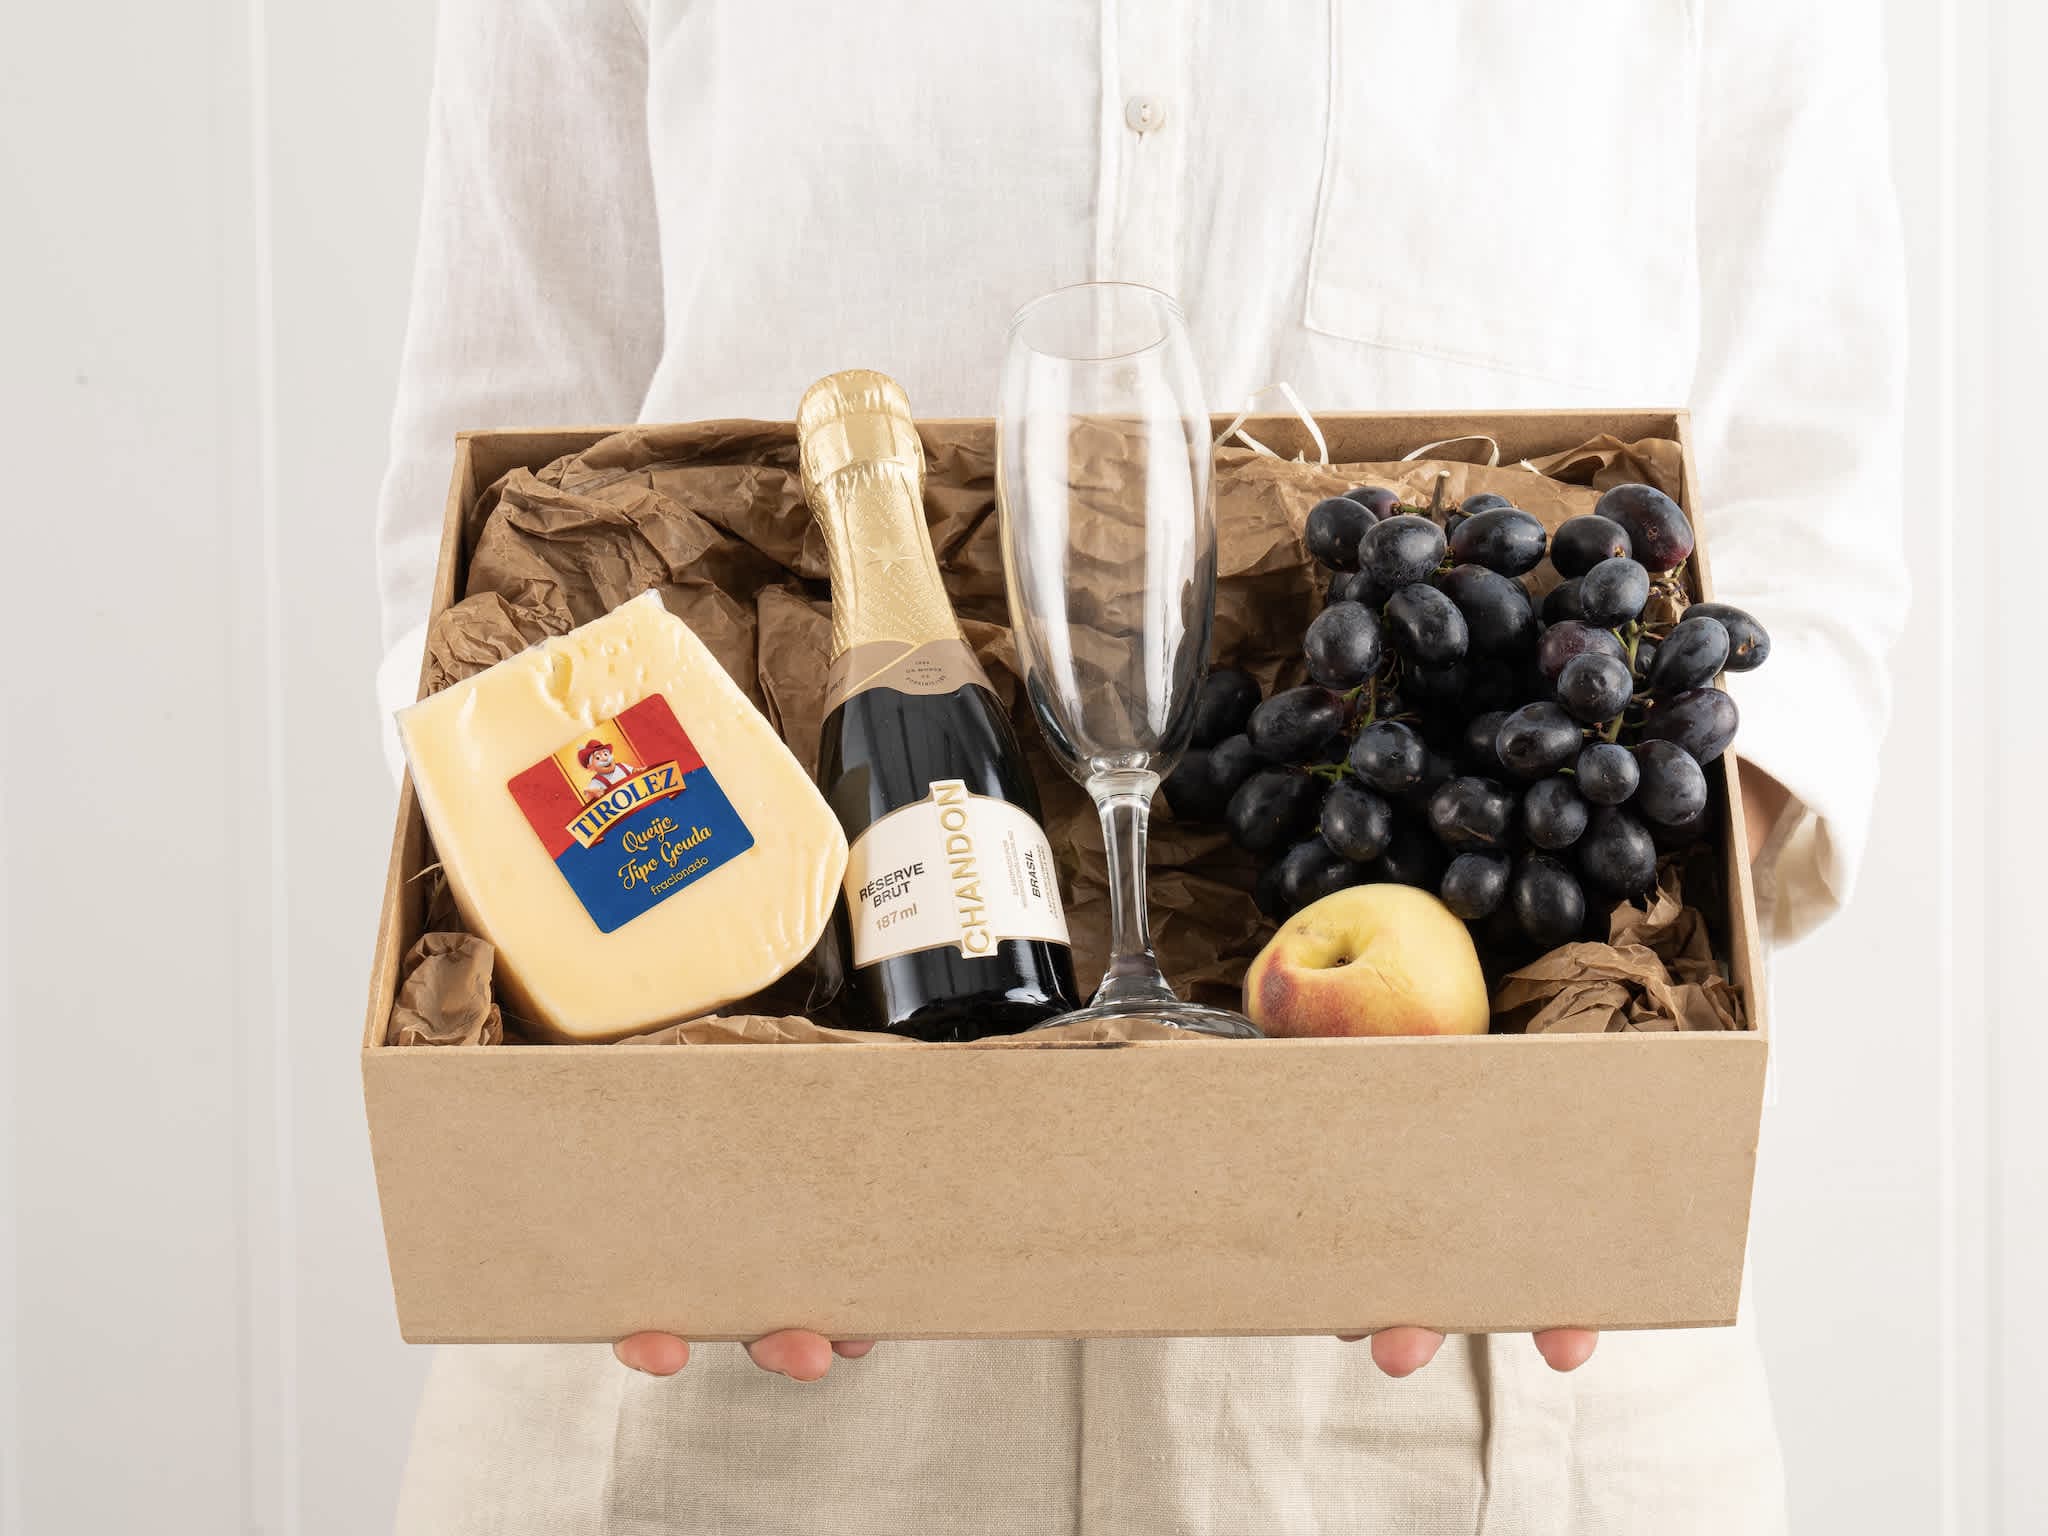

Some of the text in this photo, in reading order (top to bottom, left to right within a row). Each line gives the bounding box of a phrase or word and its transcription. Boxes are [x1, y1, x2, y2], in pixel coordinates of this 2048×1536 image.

[572, 767, 679, 839] TIROLEZ
[617, 824, 713, 890] Tipo Gouda
[621, 815, 679, 855] Queijo
[650, 856, 709, 896] fracionado
[859, 862, 925, 902] RÉSERVE
[936, 784, 991, 954] CHANDON
[1025, 850, 1041, 898] BRASIL
[873, 881, 911, 908] BRUT
